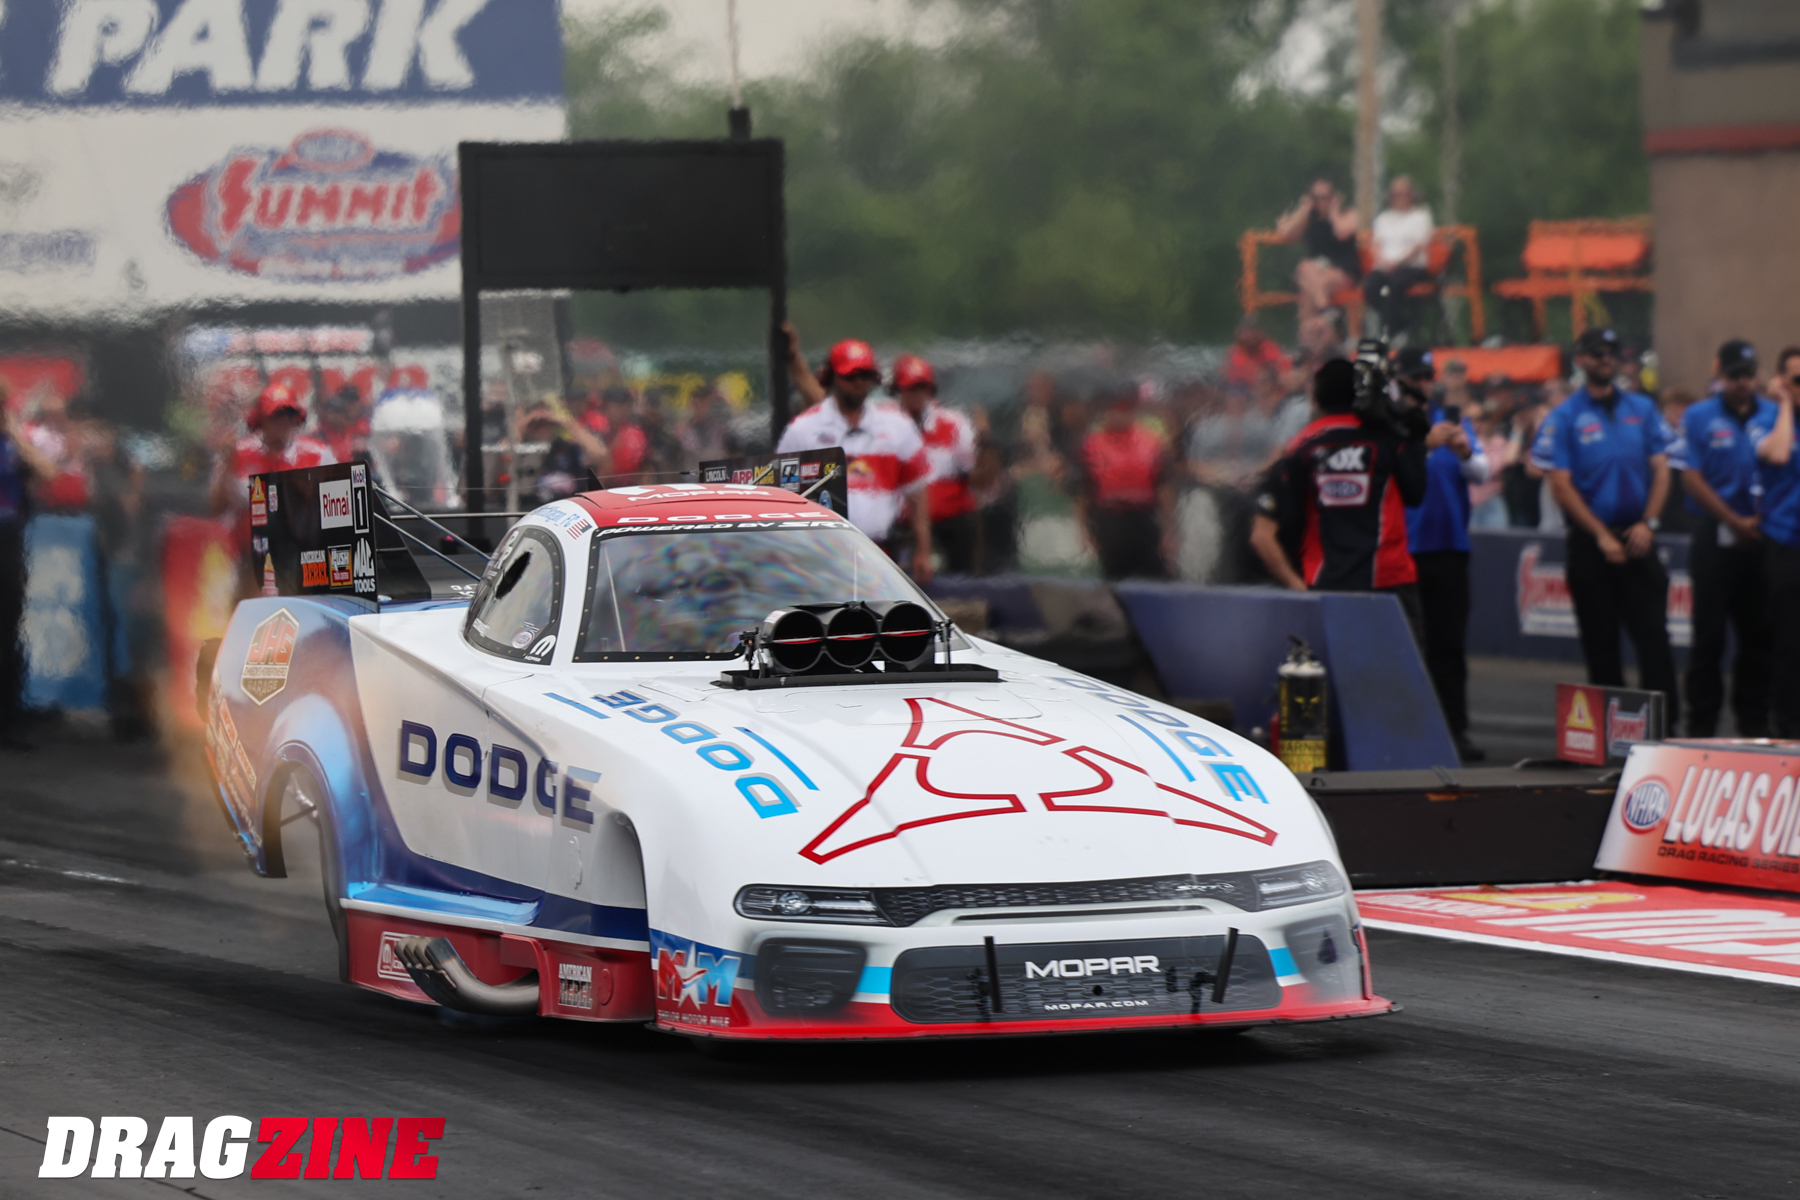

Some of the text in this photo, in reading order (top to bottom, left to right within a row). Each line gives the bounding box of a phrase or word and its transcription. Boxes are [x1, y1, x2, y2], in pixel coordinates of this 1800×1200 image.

[46, 0, 487, 97] PARK
[352, 469, 365, 484] Mobil
[705, 469, 726, 482] LINCOLN
[732, 470, 752, 484] ARP
[322, 489, 351, 517] Rinnai
[627, 490, 773, 501] MOPAR
[357, 489, 365, 527] 1
[617, 511, 829, 523] DODGE
[596, 523, 734, 537] POWERED
[301, 550, 325, 564] AMERICAN
[353, 538, 375, 577] MAC
[303, 562, 329, 587] REBEL
[354, 579, 375, 593] TOOLS
[247, 680, 278, 697] GARAGE
[1045, 676, 1270, 804] DODGE
[590, 690, 802, 819] DODGE
[398, 719, 602, 832] DODGE
[1626, 783, 1669, 827] NHRA
[1663, 765, 1771, 851] LUCAS
[1658, 846, 1800, 873] DRAG RACING SERIES
[558, 963, 592, 982] AMERICAN
[1025, 955, 1161, 978] MOPAR
[558, 979, 592, 1009] REBEL
[1044, 1000, 1149, 1011] MOPAR.COM
[682, 1012, 707, 1025] MOTOR
[709, 1016, 730, 1027] MILE
